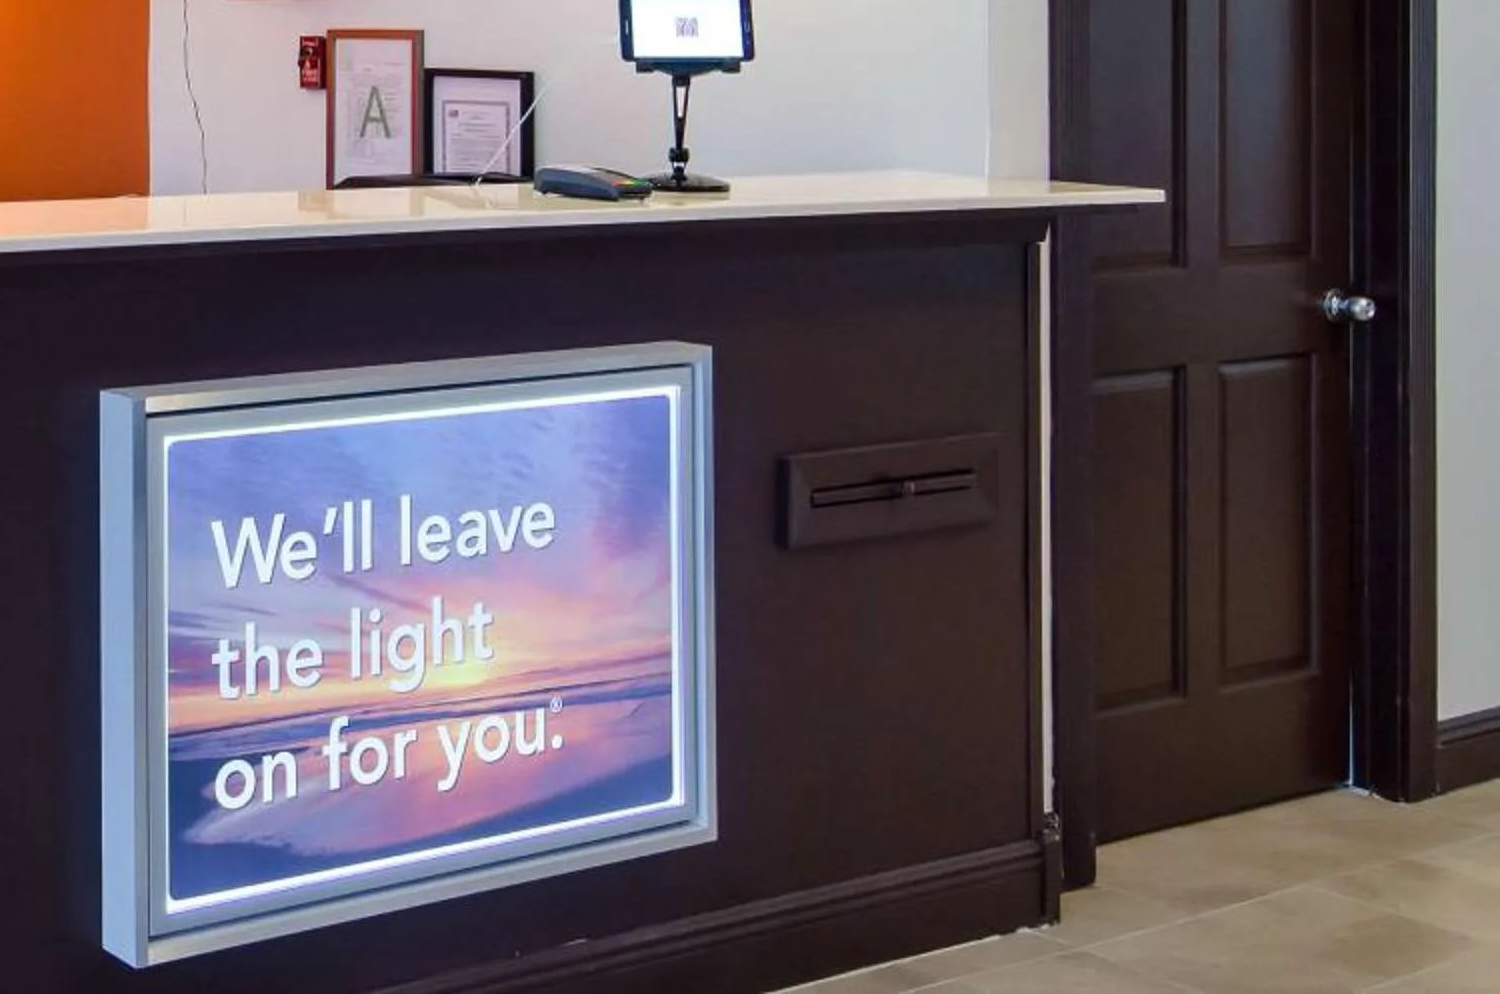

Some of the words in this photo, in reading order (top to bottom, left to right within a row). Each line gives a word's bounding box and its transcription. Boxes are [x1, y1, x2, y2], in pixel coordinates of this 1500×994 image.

[360, 85, 392, 139] A
[211, 499, 374, 589] We'll
[400, 494, 556, 566] leave
[211, 622, 323, 701] the
[350, 595, 495, 693] light
[214, 751, 298, 812] on
[322, 717, 418, 790] for
